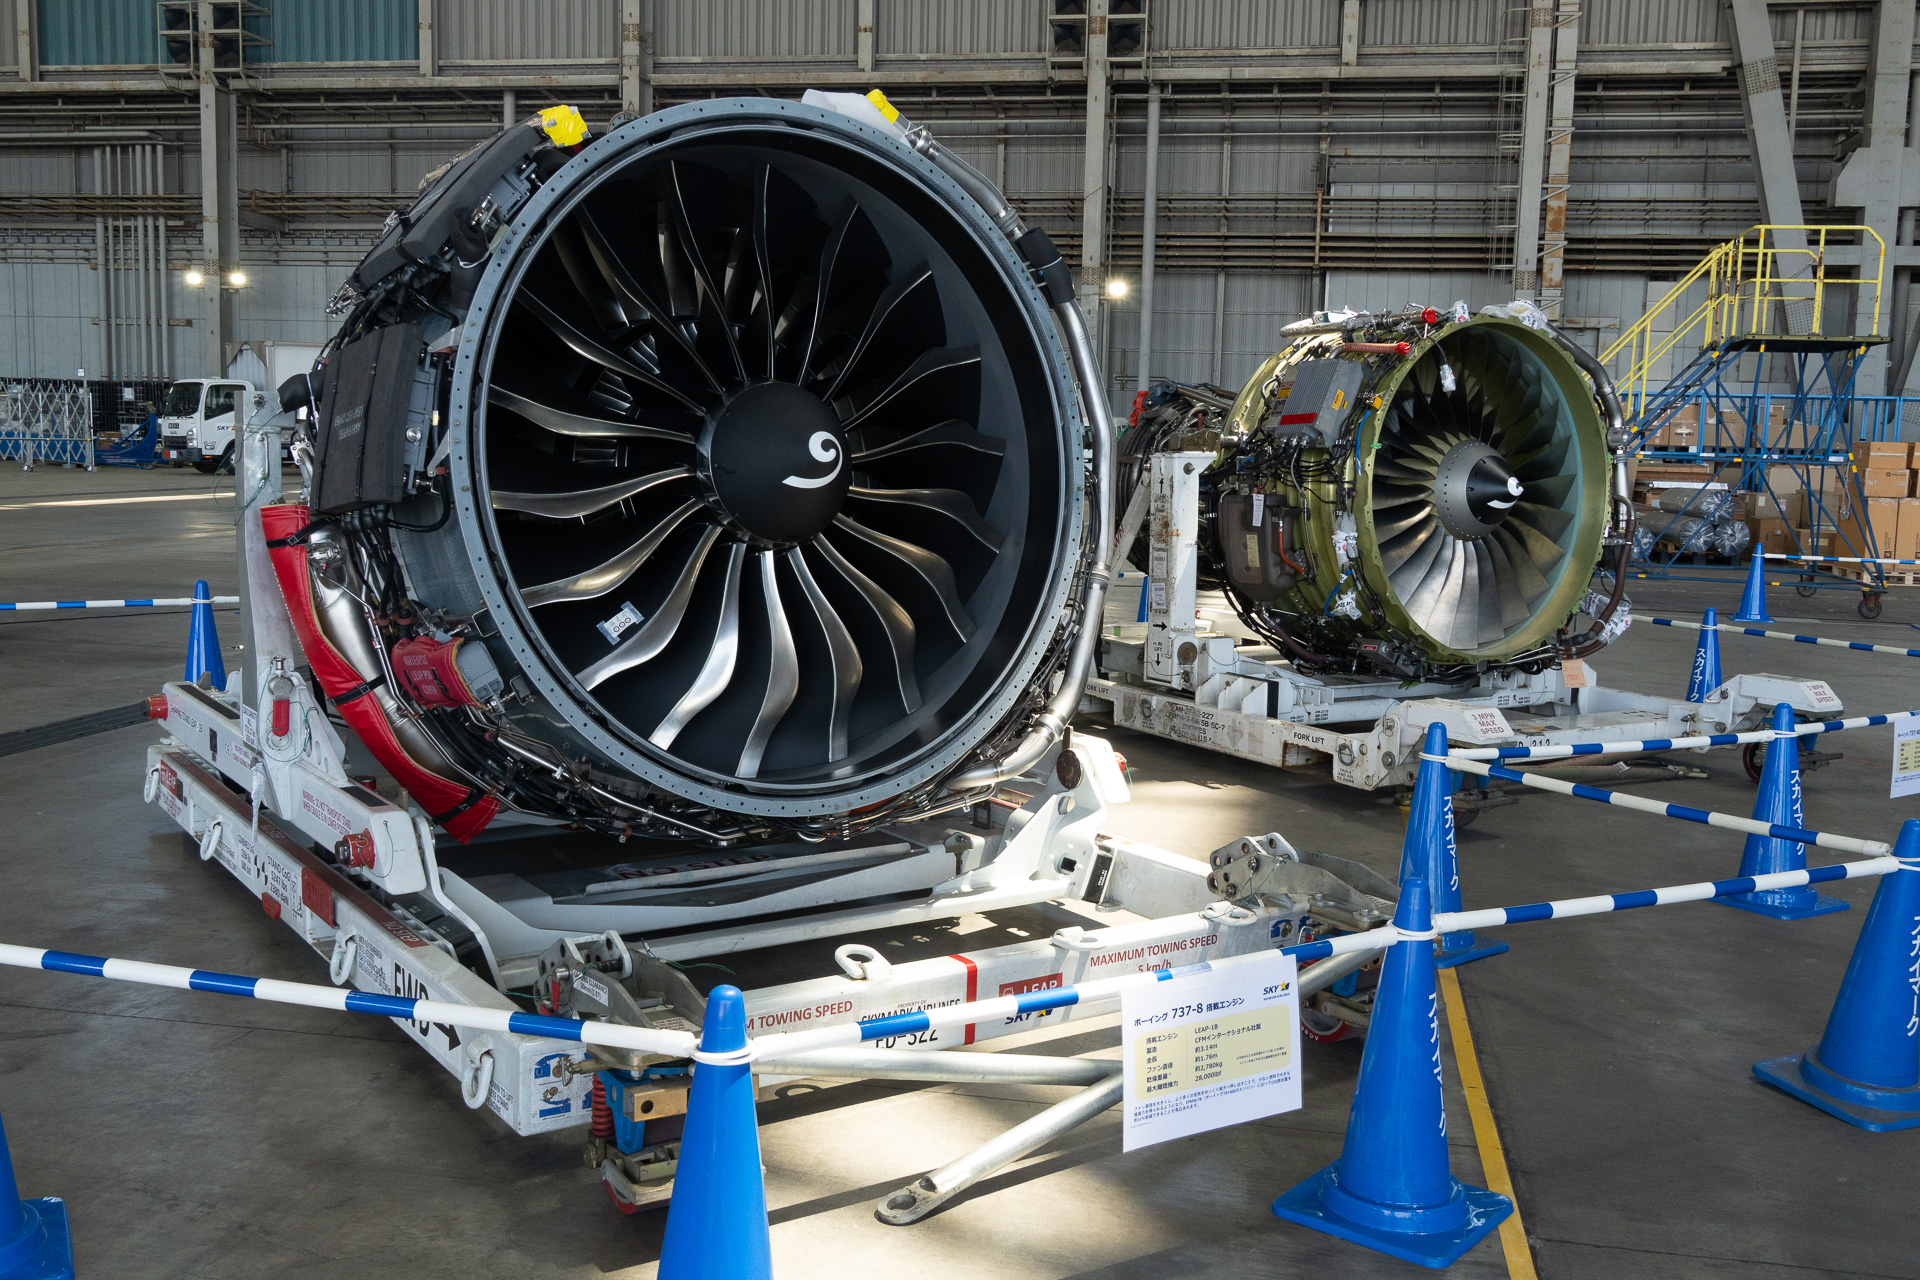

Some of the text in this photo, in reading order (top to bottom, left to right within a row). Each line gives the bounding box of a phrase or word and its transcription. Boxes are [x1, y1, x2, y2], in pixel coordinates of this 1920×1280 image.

[1690, 648, 1706, 702] スカイマーク
[1086, 684, 1097, 692] ORK
[1478, 712, 1496, 720] MPH
[1293, 732, 1325, 745] FORK LIFT
[1480, 726, 1505, 735] SPEED
[1791, 769, 1805, 856] スカイマク
[1443, 796, 1459, 891] スカイマーク
[267, 855, 281, 874] STAND
[685, 853, 770, 871] STEP
[381, 920, 420, 943] NO STEP
[1090, 934, 1218, 968] MAXIMUM TOWING SPEED
[1138, 958, 1172, 973] 5 km/h
[1262, 984, 1280, 995] SKY
[394, 961, 429, 1037] FWD
[897, 1000, 920, 1009] PROPERTY
[758, 1007, 812, 1028] TOWING
[815, 1000, 853, 1018] SPEED
[1133, 997, 1245, 1027] ボーイング 737-8 搭載エンジン
[1194, 1023, 1219, 1034] LEAP-1B
[1194, 1023, 1261, 1043] CFMインターナショナル社製
[1194, 1044, 1218, 1053] 約3.14m
[1194, 1053, 1218, 1063] 約1.76m
